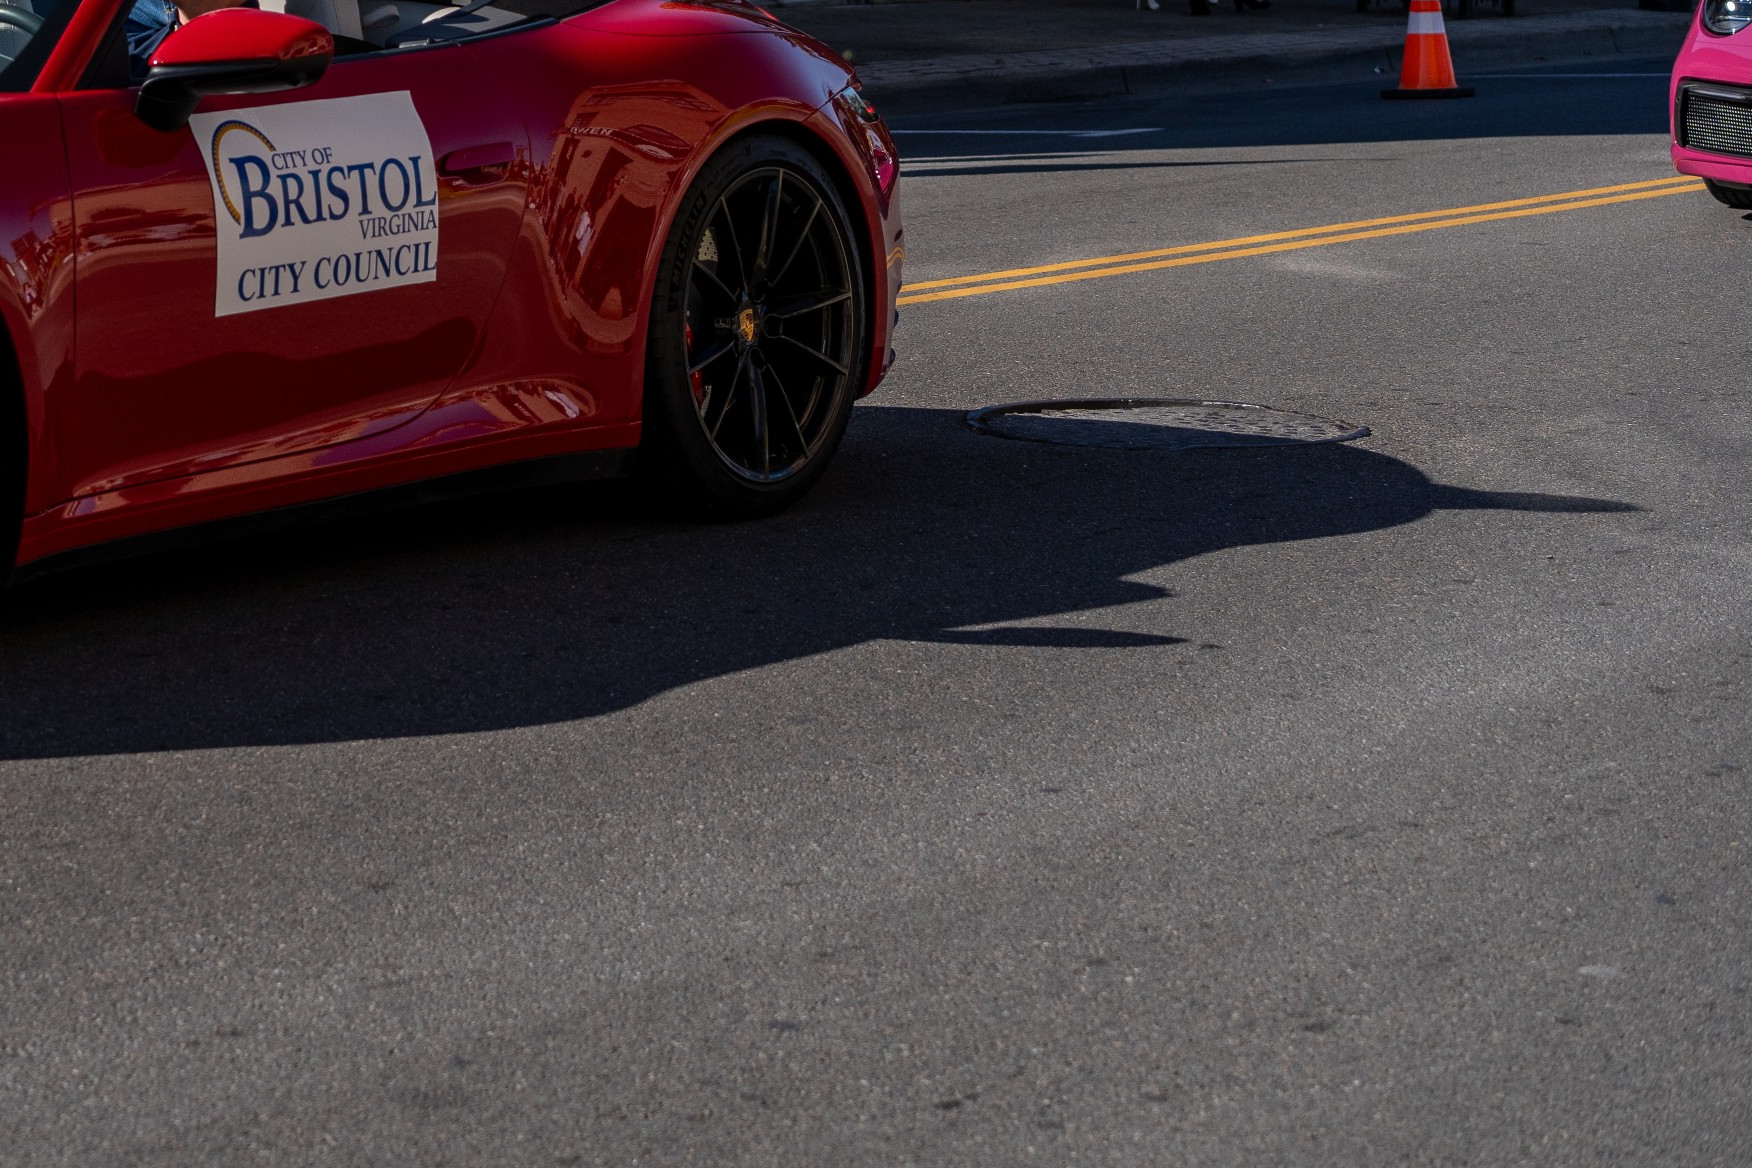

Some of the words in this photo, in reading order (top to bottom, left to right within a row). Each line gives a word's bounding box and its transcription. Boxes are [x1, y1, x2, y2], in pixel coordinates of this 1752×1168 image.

[271, 149, 307, 171] CITY
[311, 146, 333, 166] OF
[228, 154, 437, 240] BRISTOL
[359, 209, 438, 240] VIRGINIA
[237, 260, 306, 302] CITY
[313, 241, 437, 289] COUNCIL
